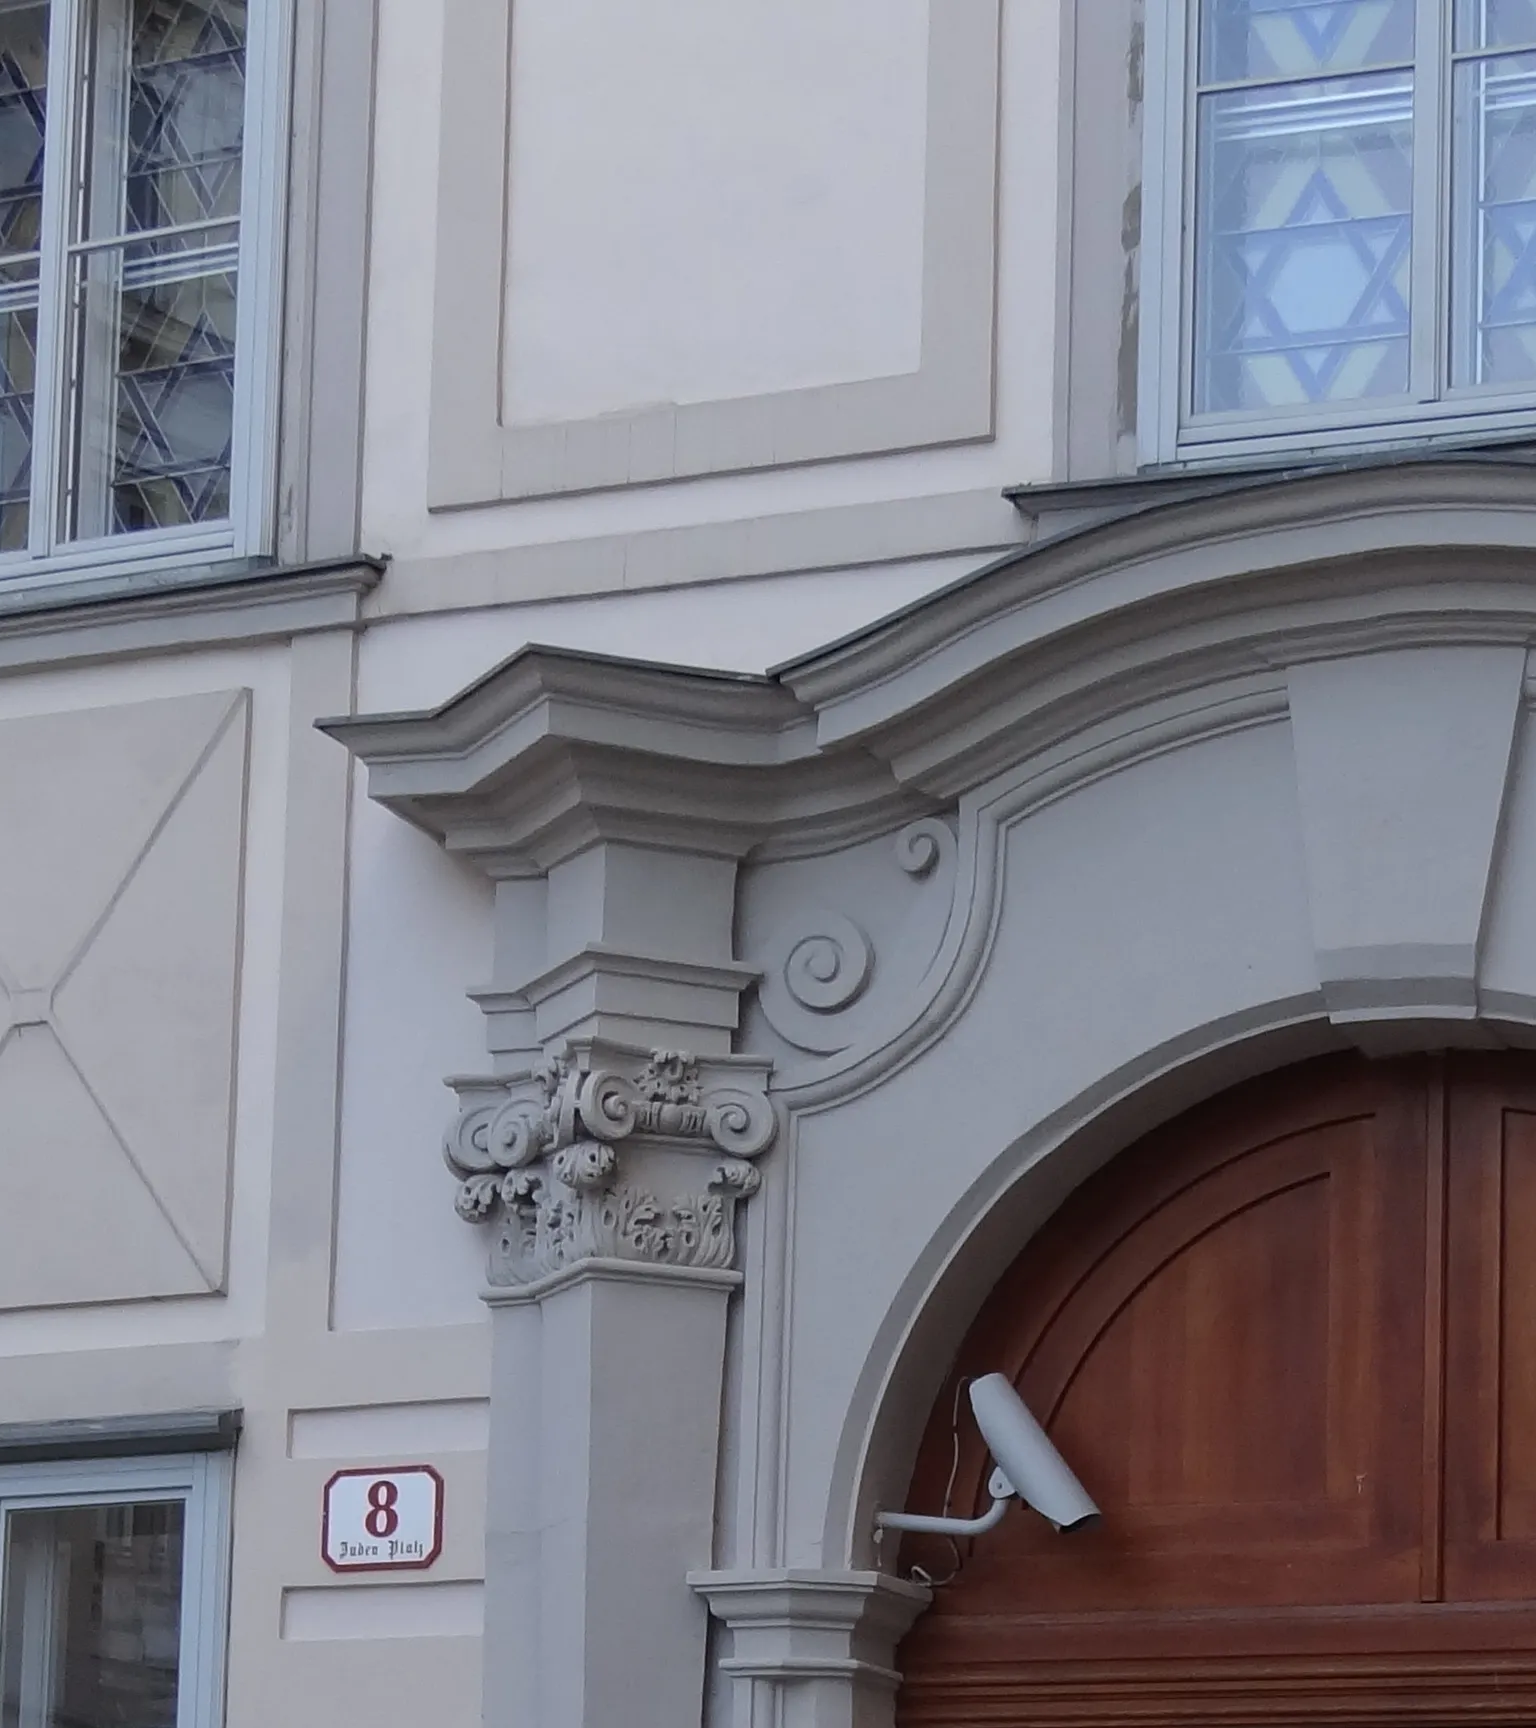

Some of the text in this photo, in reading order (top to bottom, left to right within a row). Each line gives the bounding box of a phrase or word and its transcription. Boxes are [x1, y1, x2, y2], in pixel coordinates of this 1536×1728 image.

[365, 1480, 399, 1538] 8
[339, 1539, 424, 1561] Juden Platz
